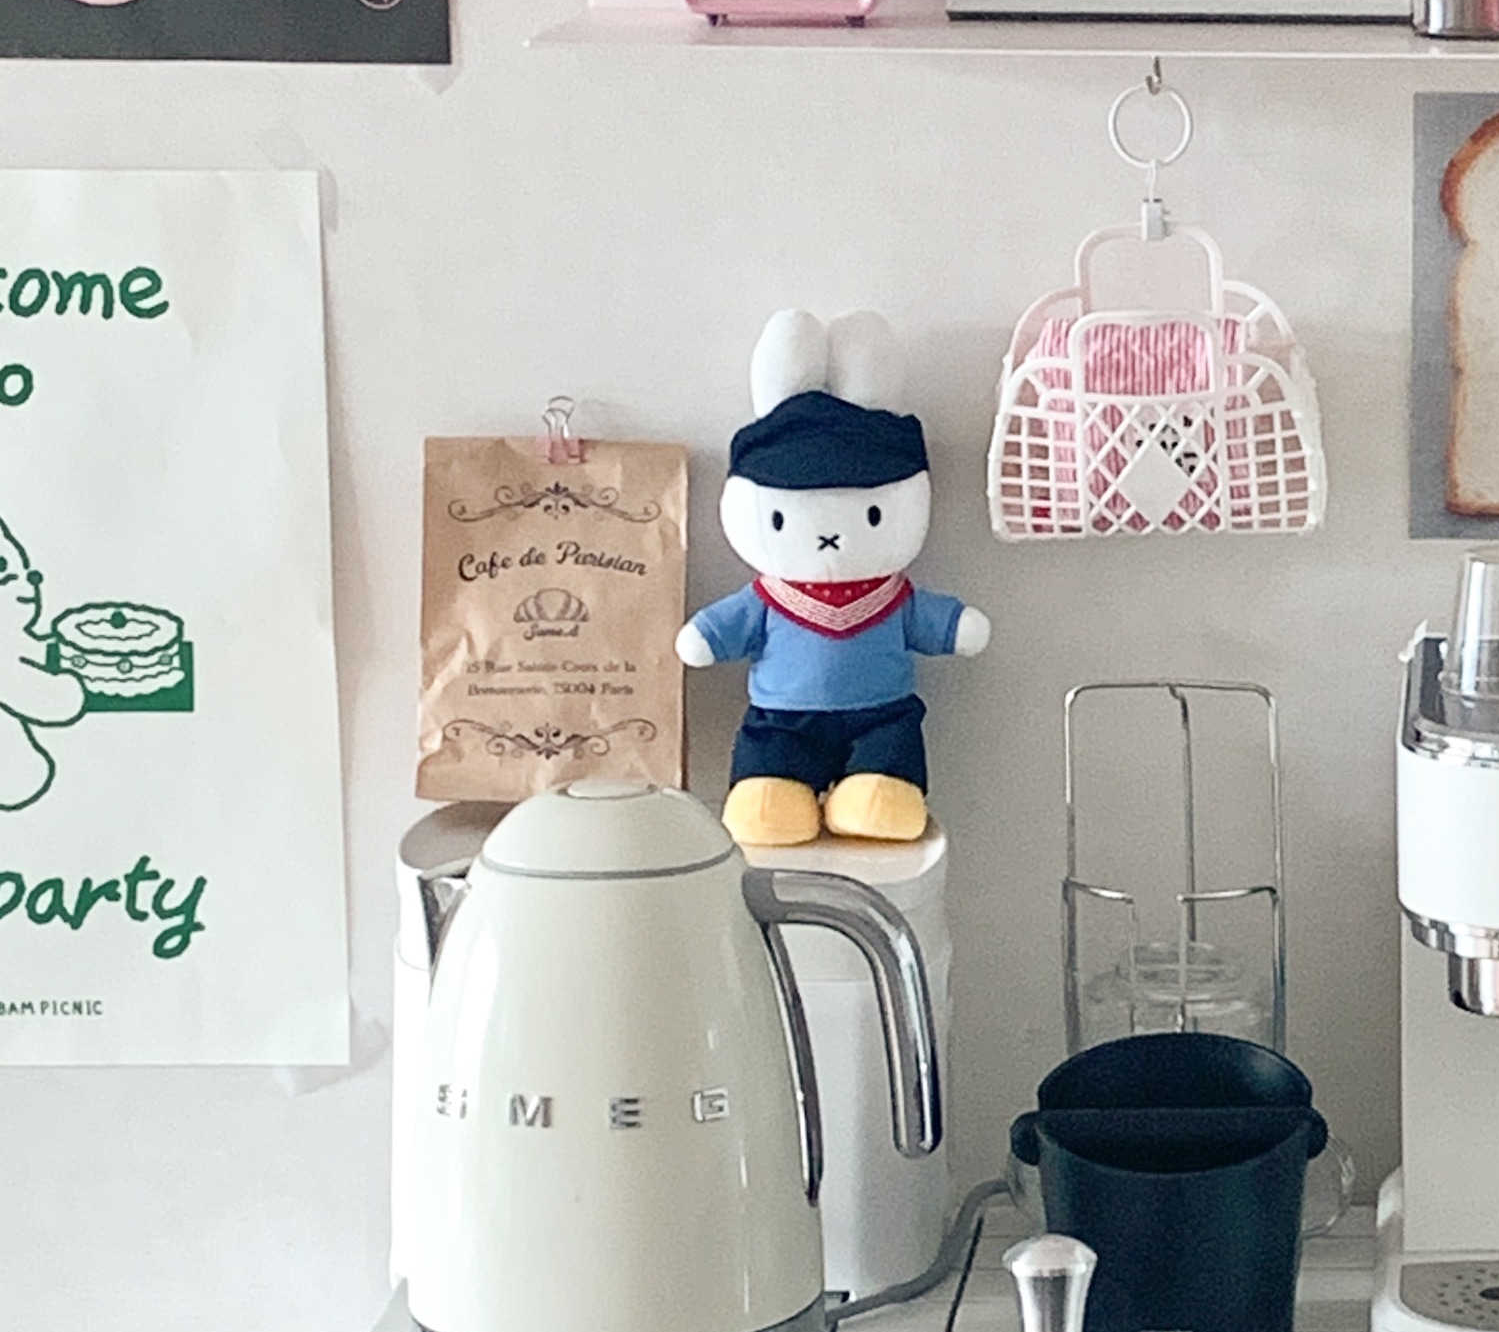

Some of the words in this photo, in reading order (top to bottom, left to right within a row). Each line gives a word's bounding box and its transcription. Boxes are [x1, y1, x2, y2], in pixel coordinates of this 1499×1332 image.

[0, 266, 169, 320] ome
[458, 552, 512, 582] Cafe
[518, 547, 546, 568] de
[556, 540, 648, 576] Parisian
[40, 1000, 103, 1016] PICNIC
